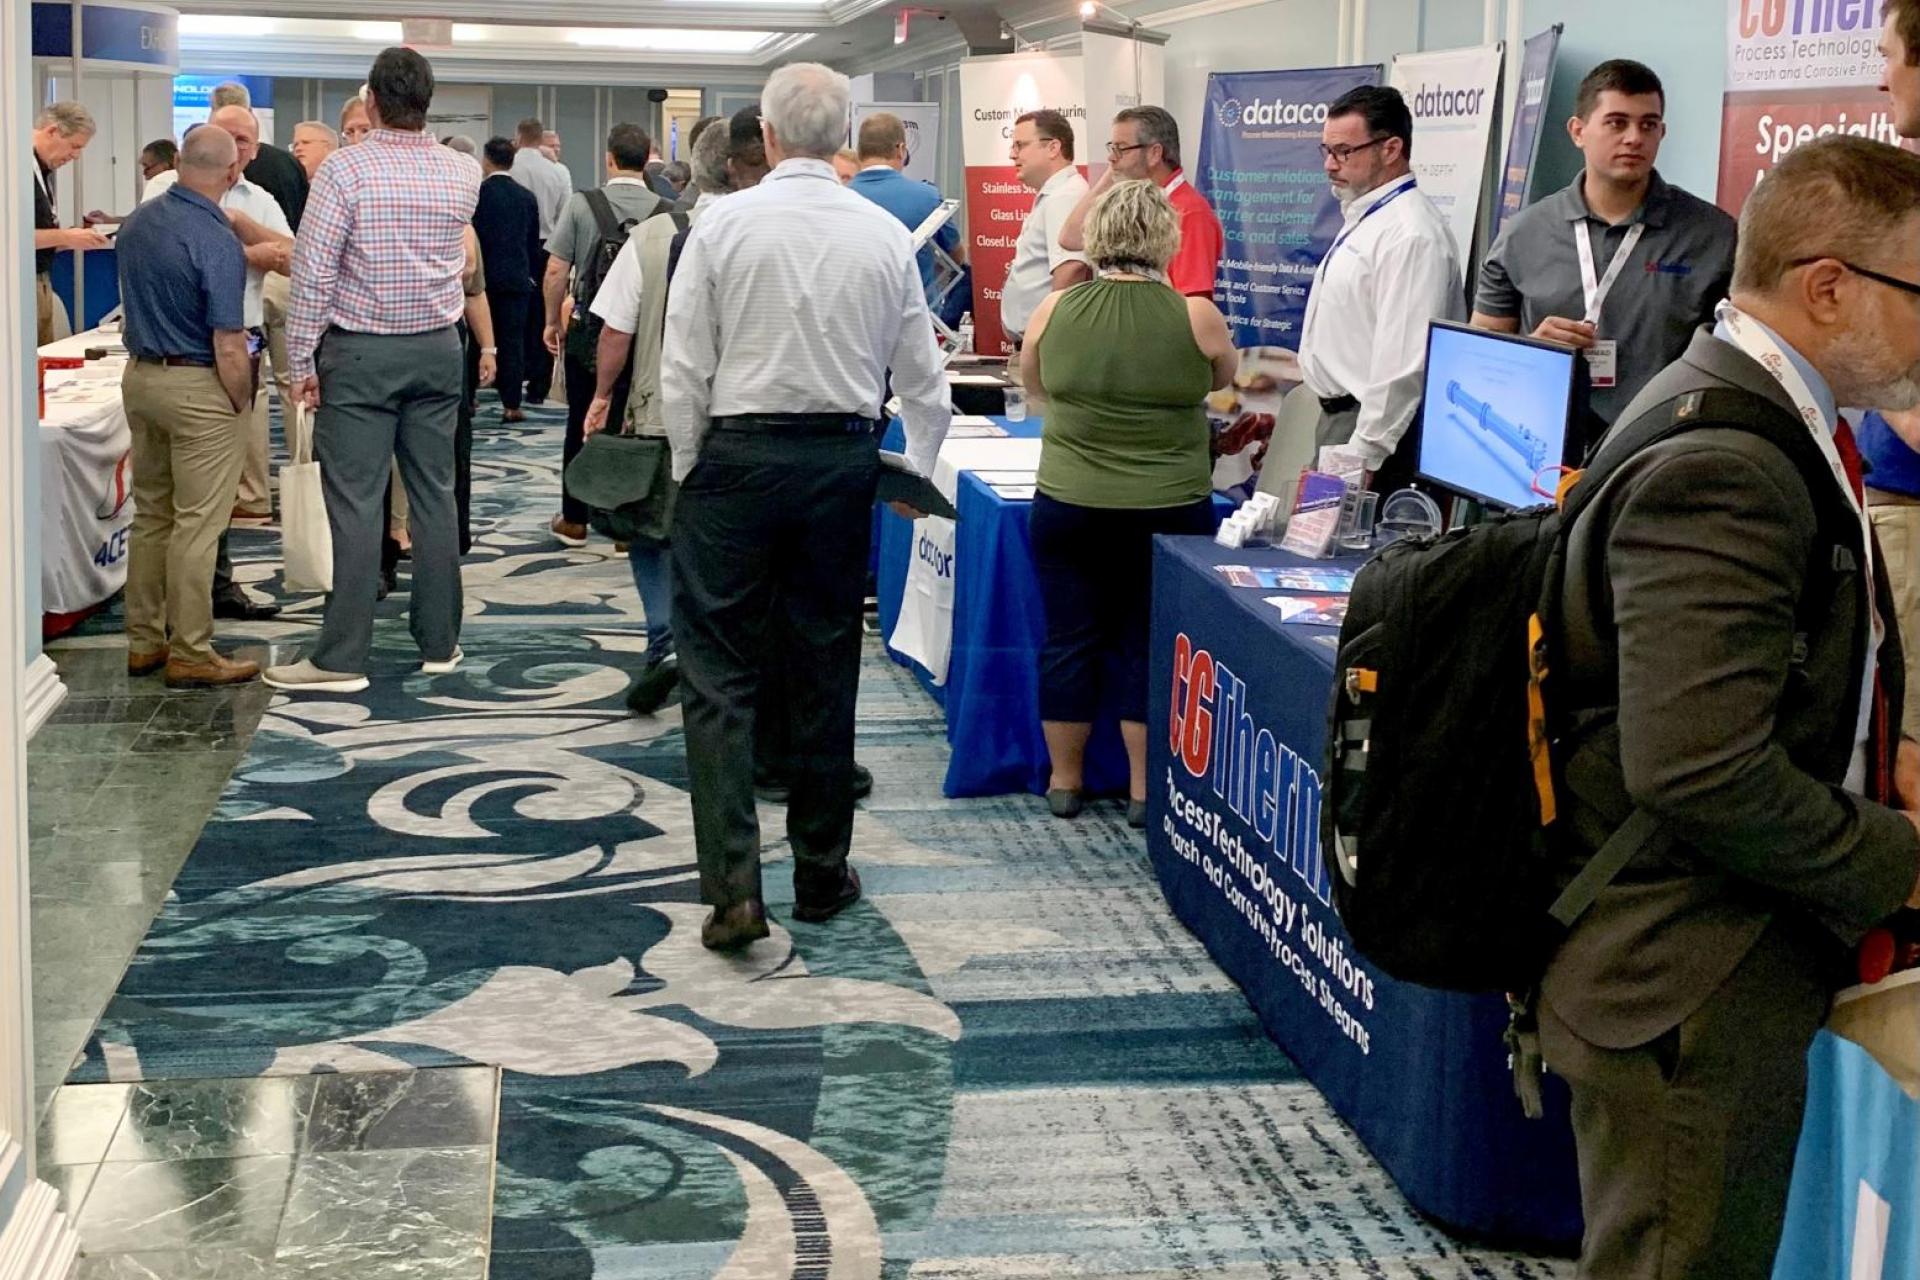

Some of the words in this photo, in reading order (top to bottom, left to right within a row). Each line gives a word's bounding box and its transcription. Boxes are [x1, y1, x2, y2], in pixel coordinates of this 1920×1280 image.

[1735, 45, 1786, 61] Process
[1792, 37, 1879, 59] Technology
[1747, 65, 1776, 81] Harsh
[1779, 65, 1801, 80] and
[1804, 64, 1857, 79] Corrosive
[1414, 83, 1484, 118] datacor
[974, 109, 1012, 122] Custom
[1208, 167, 1269, 184] Customer
[982, 182, 1022, 195] Stainless
[1208, 190, 1294, 206] anagement
[1297, 190, 1315, 203] for
[990, 209, 1014, 221] Glass
[1258, 209, 1317, 224] customer
[976, 235, 1005, 249] Closed
[1249, 229, 1276, 245] and
[1233, 281, 1249, 291] and
[1250, 282, 1281, 294] Customer
[1282, 285, 1306, 297] Service
[1226, 292, 1247, 304] Tools
[1250, 316, 1262, 327] for
[1212, 812, 1297, 933] Technology
[1301, 902, 1375, 1011] Solutions
[1318, 977, 1371, 1056] Streams
